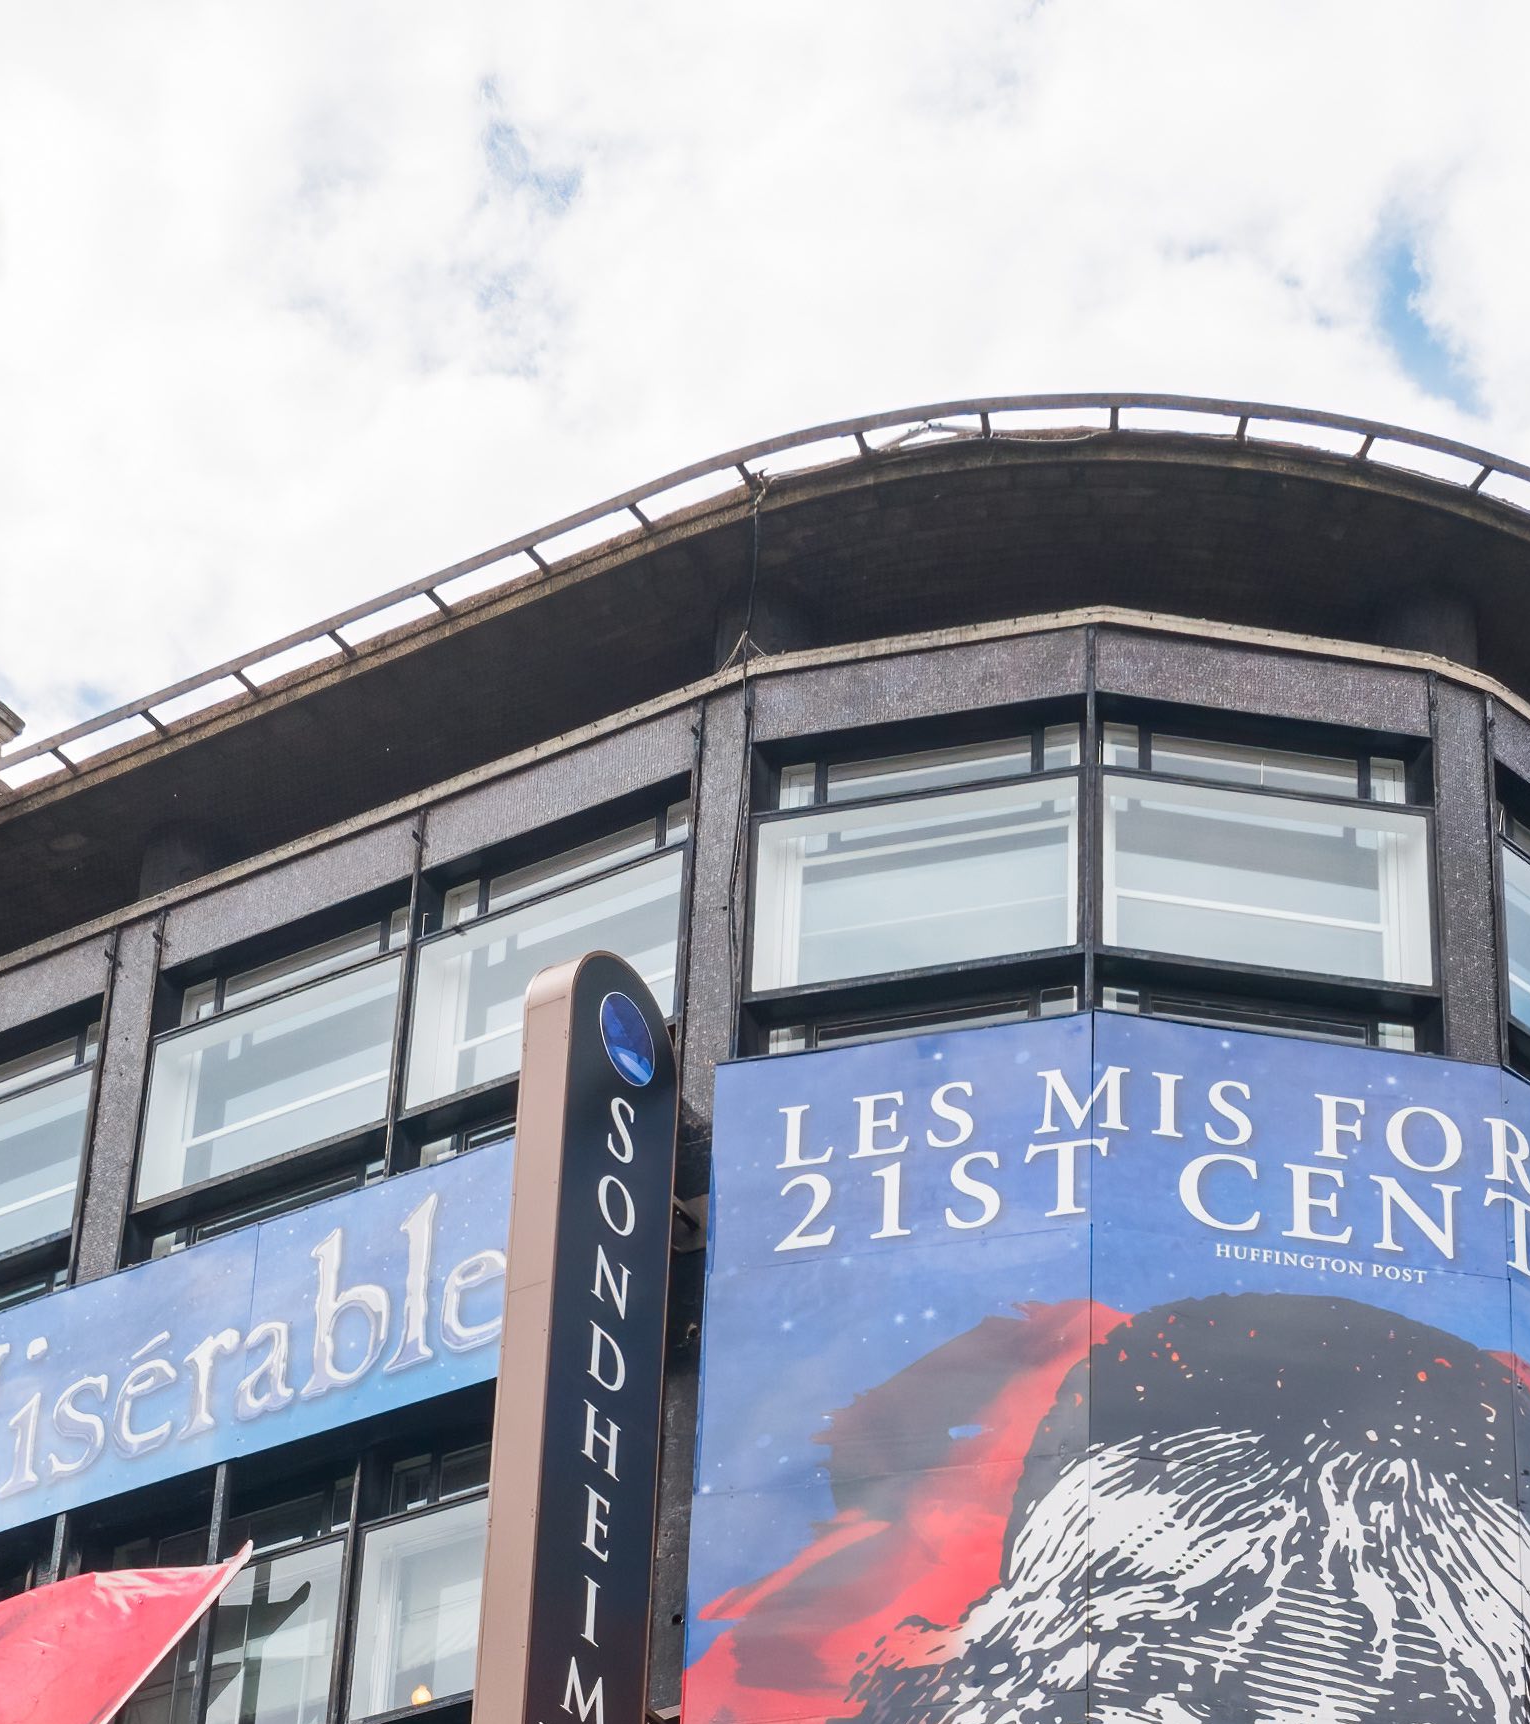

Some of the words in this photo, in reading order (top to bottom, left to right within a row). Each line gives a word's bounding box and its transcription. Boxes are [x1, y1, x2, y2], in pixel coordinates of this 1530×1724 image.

[776, 1079, 975, 1170] LES
[1034, 1065, 1255, 1149] MIS
[774, 1135, 1110, 1254] 21ST
[1215, 1242, 1363, 1277] HUFFINGTON
[1372, 1263, 1428, 1284] POST
